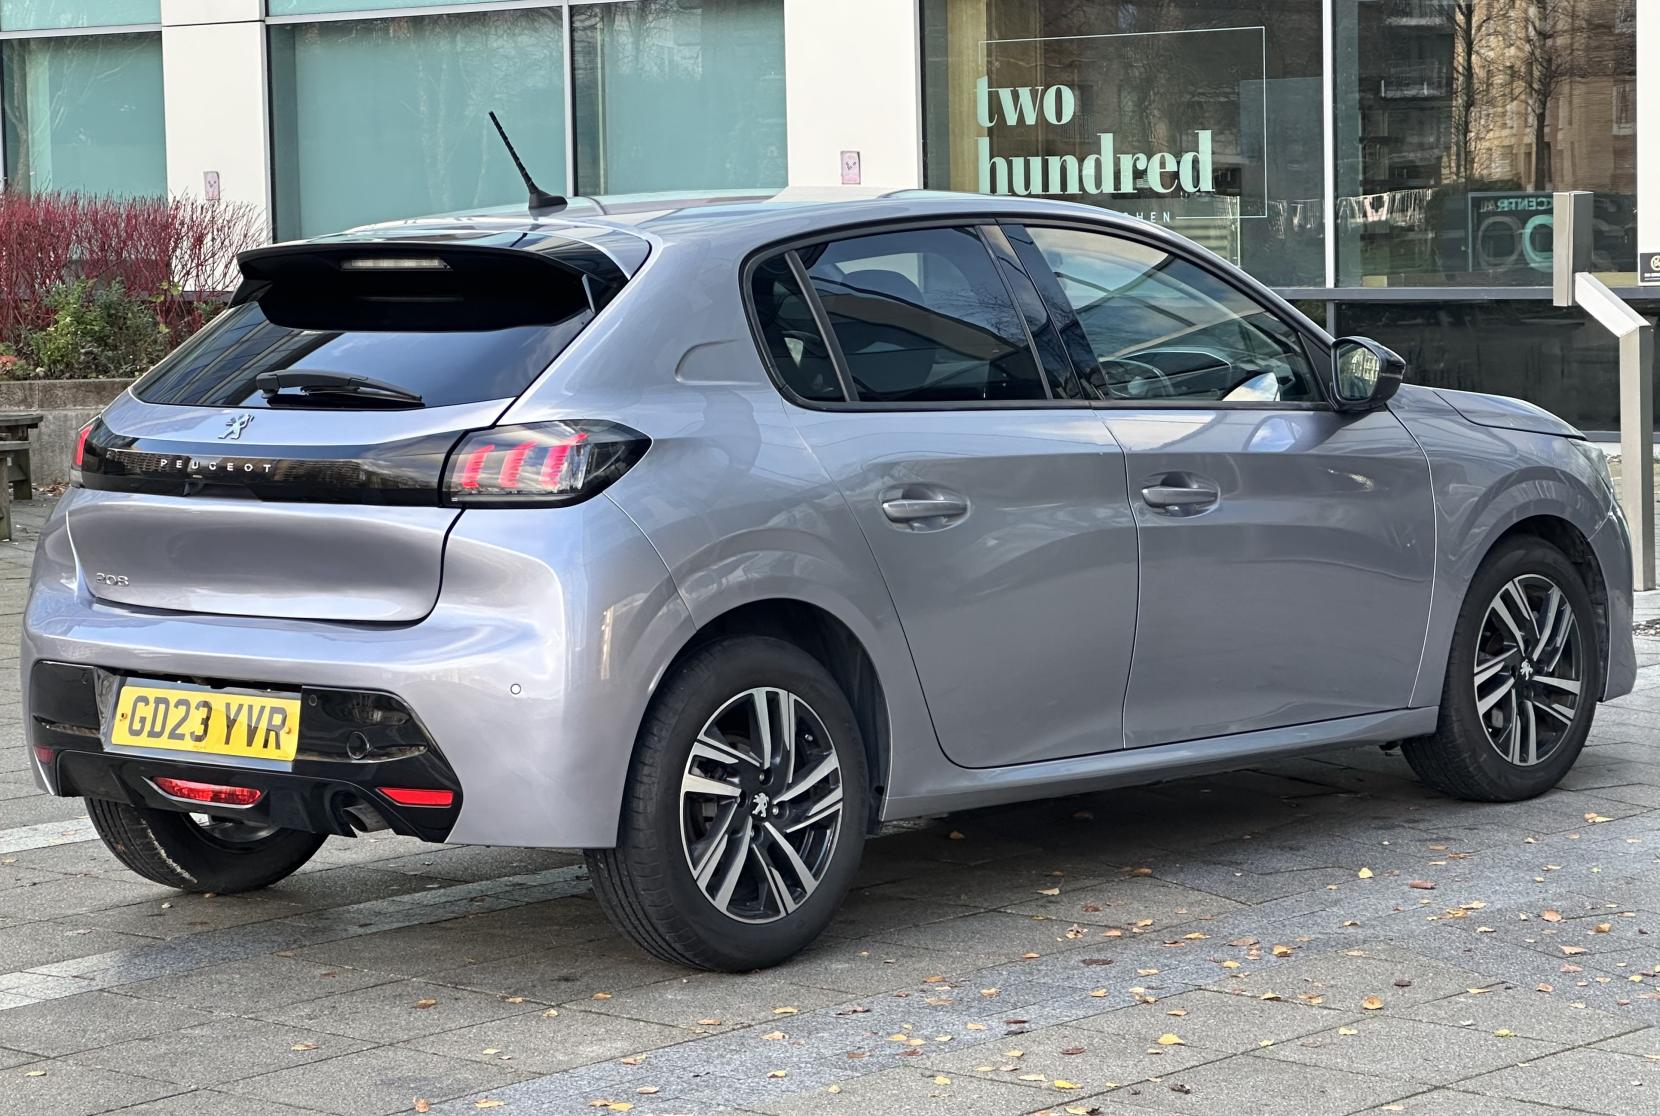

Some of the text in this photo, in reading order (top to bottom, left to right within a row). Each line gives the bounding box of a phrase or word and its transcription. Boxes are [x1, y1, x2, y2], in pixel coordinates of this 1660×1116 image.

[974, 75, 1075, 128] two
[974, 129, 1216, 196] hundred
[160, 459, 272, 473] PEUGEOT
[127, 695, 288, 750] GD23 YVR
